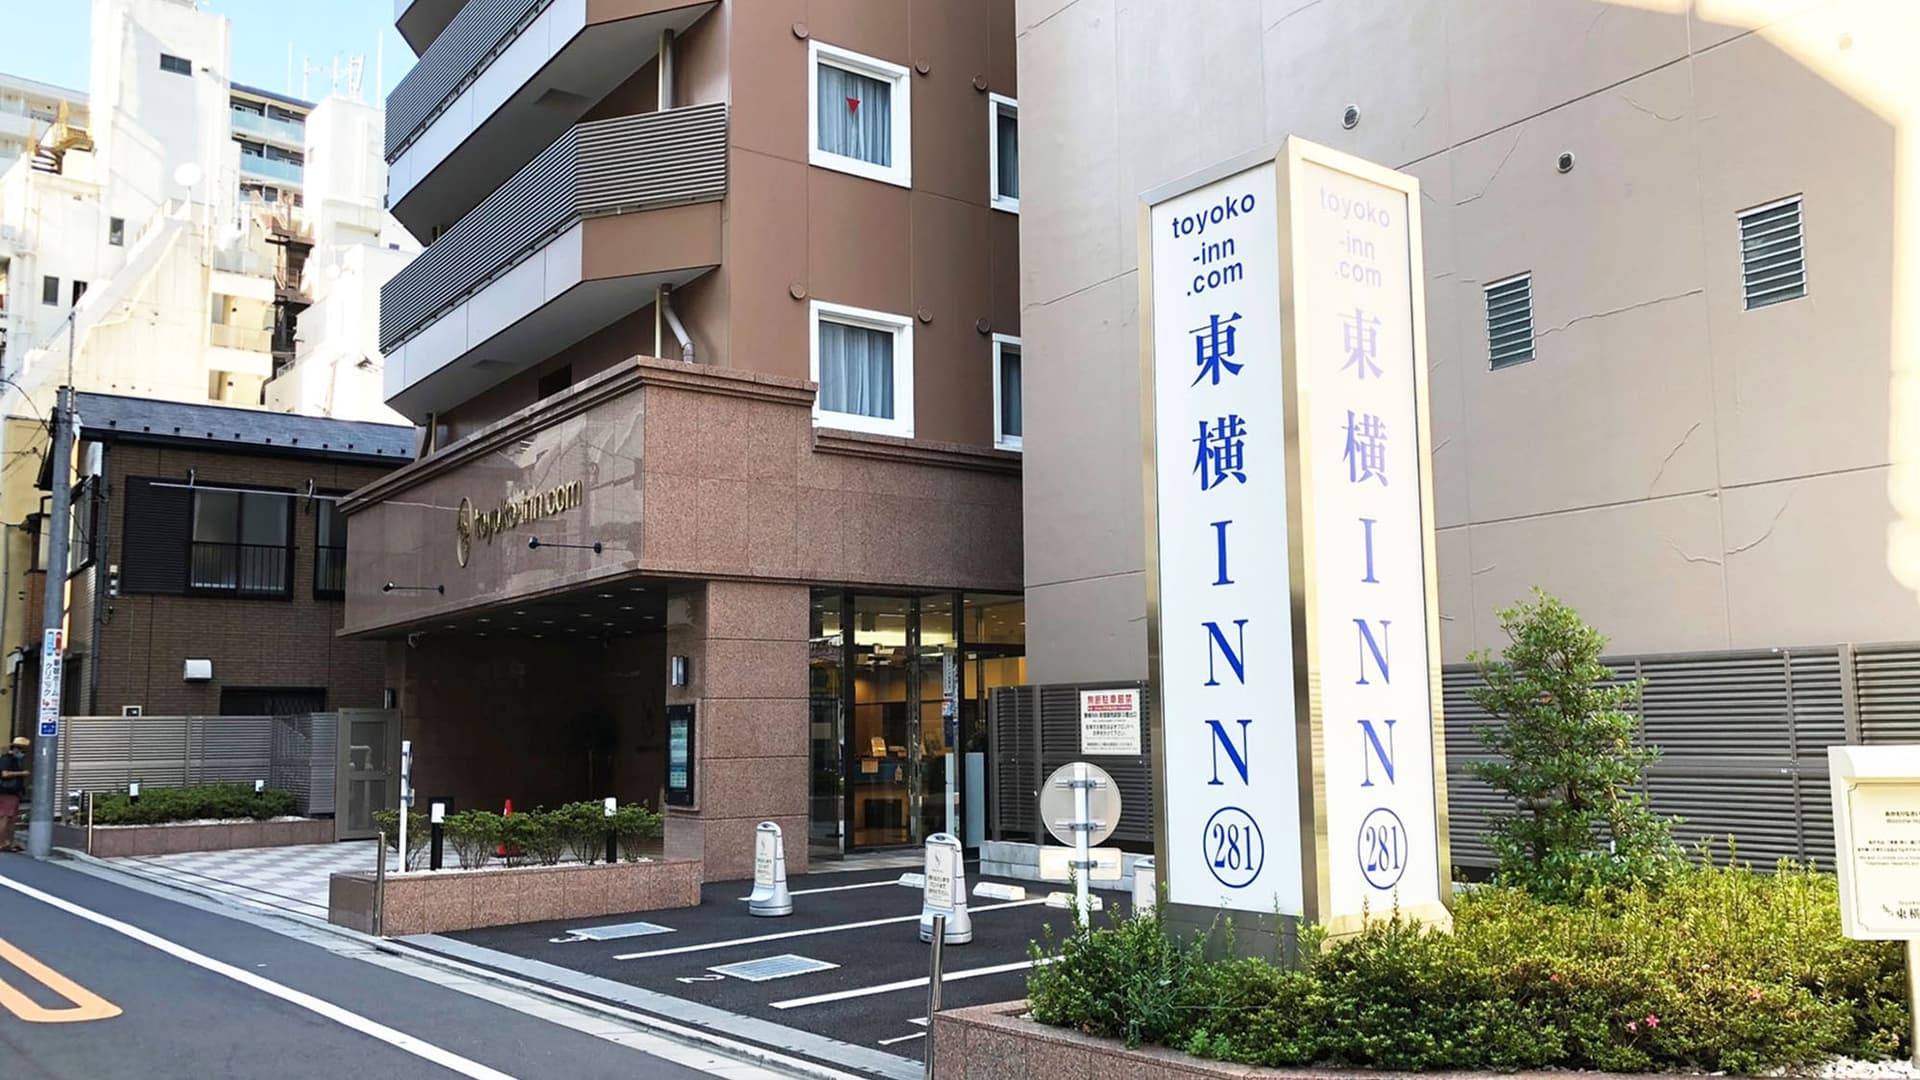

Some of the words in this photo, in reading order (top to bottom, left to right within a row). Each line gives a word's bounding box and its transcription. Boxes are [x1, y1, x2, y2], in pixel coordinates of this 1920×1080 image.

[1172, 194, 1255, 239] toyoko
[1320, 185, 1390, 228] toyoko
[1193, 238, 1235, 265] -inn
[1339, 229, 1375, 261] -inn
[1187, 262, 1243, 296] .com
[1335, 260, 1382, 288] .com
[1188, 311, 1252, 787] 東横INN
[1213, 823, 1254, 870] 281
[1366, 825, 1400, 871] 281
